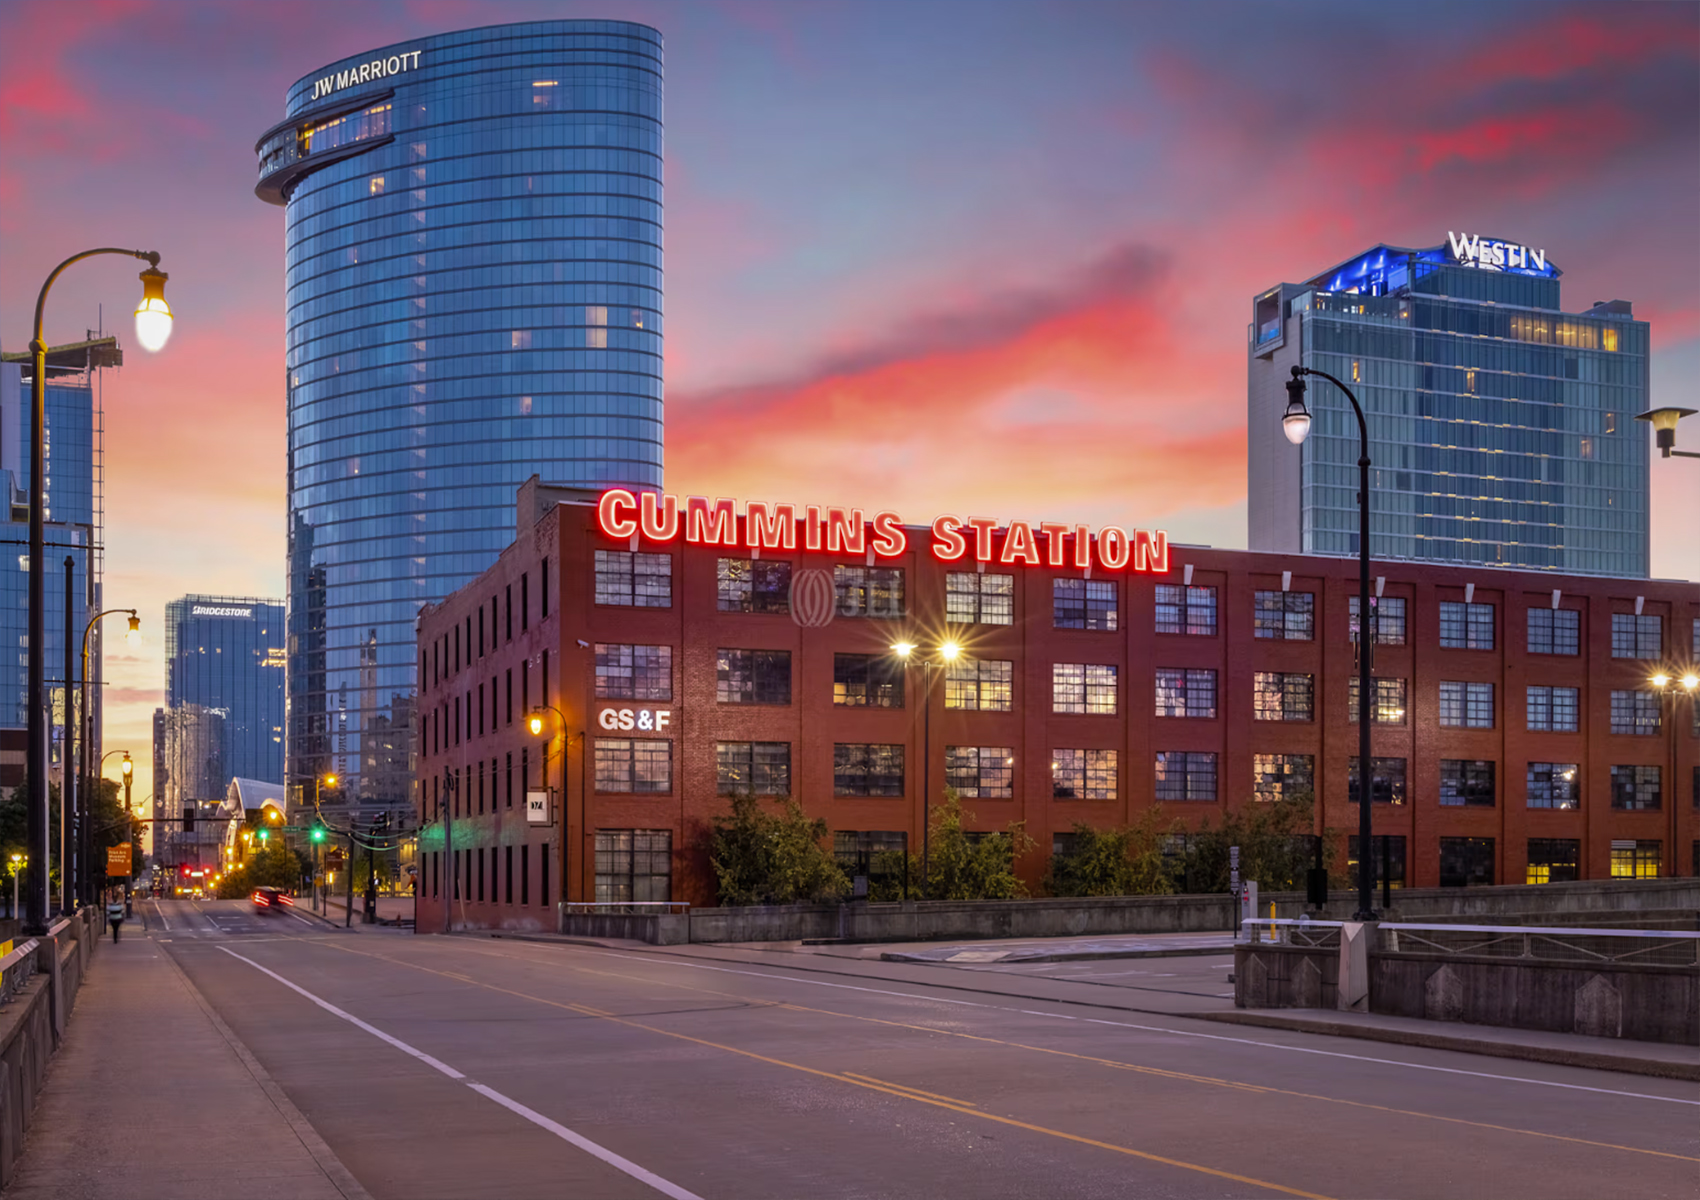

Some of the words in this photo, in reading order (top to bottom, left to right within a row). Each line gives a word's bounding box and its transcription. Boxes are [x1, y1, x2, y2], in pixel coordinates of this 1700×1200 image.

[311, 74, 335, 100] JW
[336, 50, 422, 91] MARRIOTT
[598, 488, 907, 557] CUMMINS
[931, 513, 1169, 573] STATION
[191, 605, 252, 618] BRIDGESTONE
